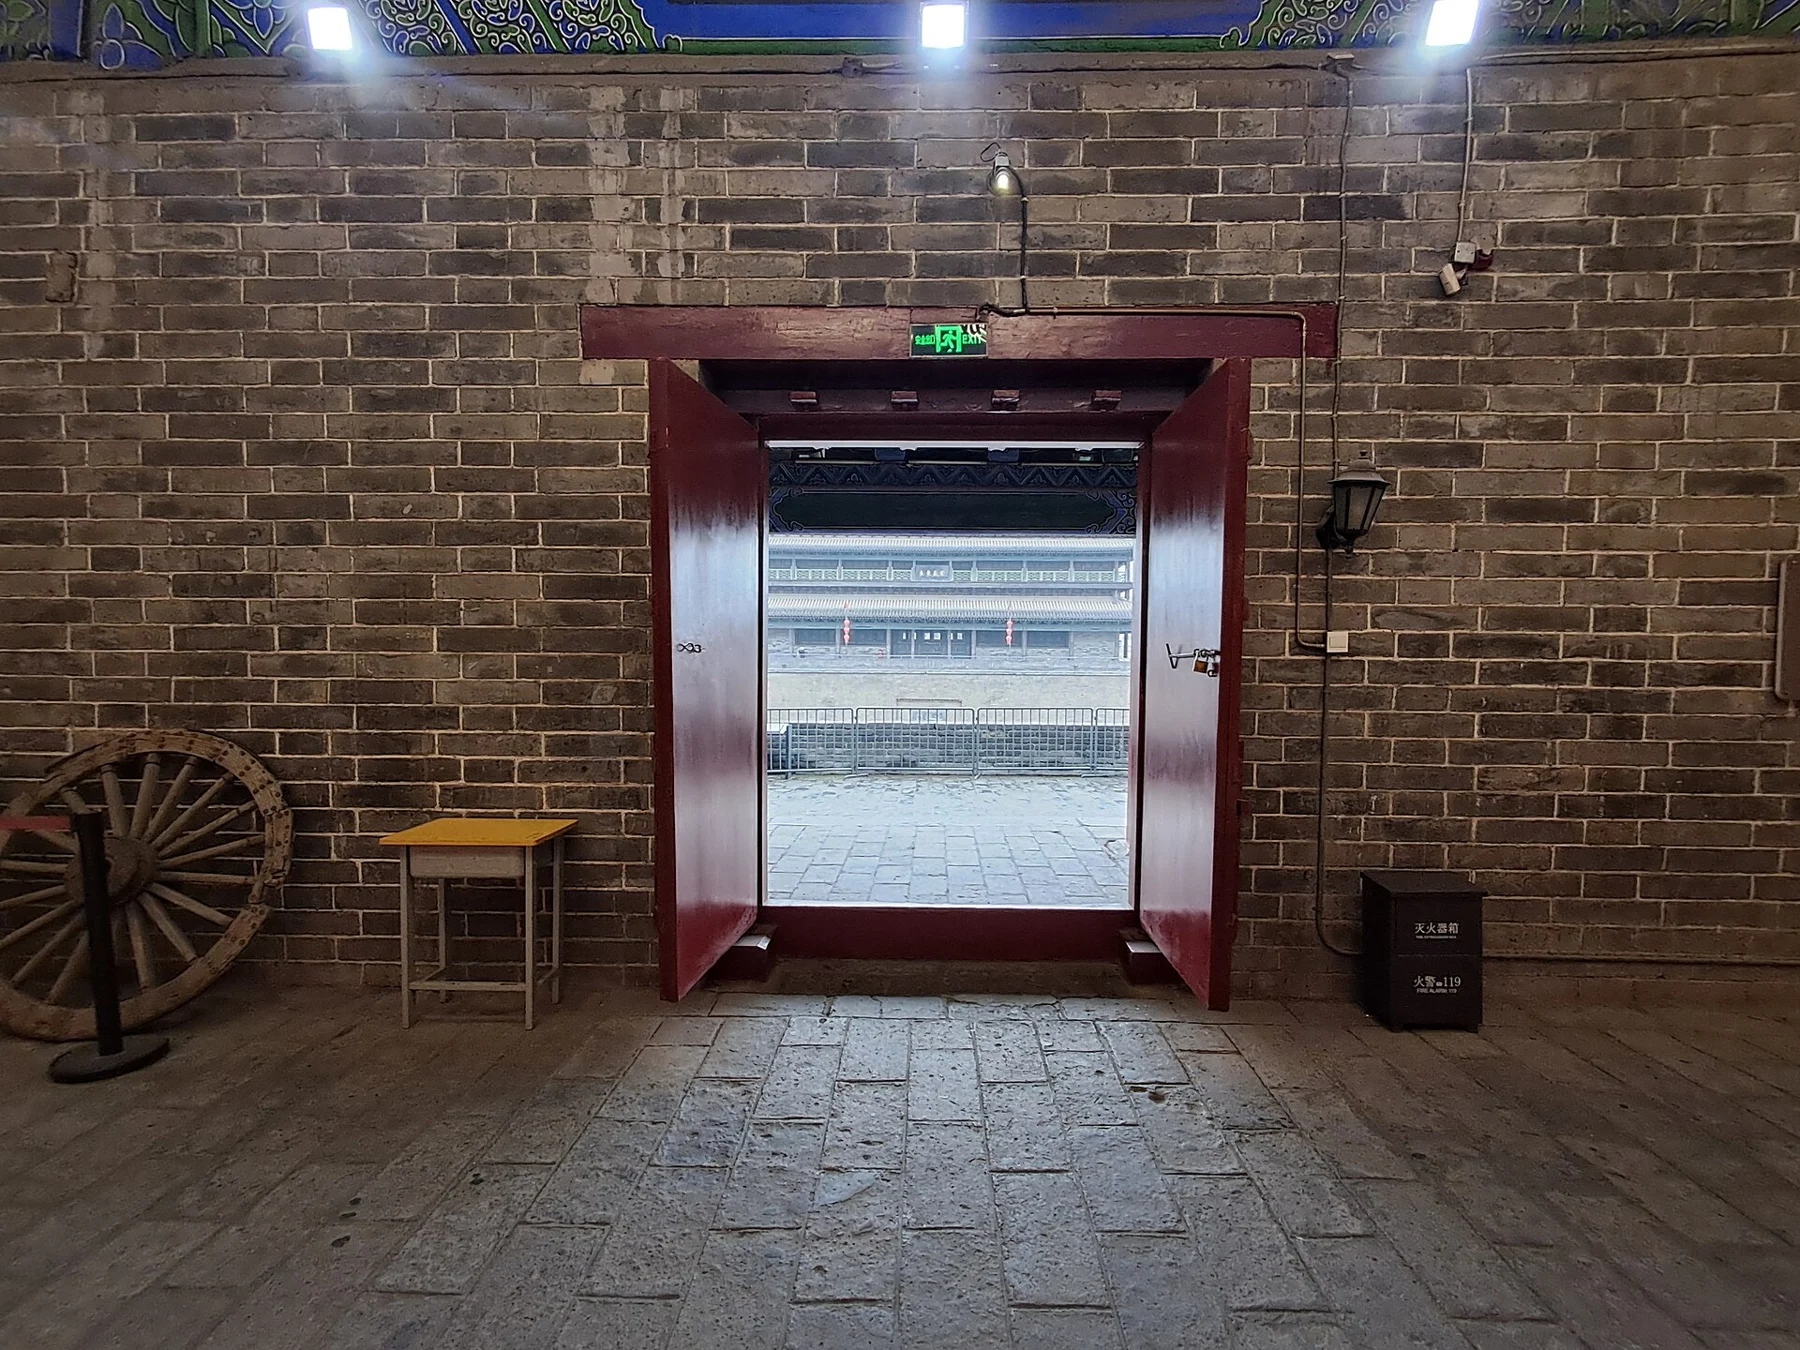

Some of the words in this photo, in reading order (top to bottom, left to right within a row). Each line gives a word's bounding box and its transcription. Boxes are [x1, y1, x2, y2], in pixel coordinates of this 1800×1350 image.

[962, 333, 982, 345] EXIT
[1414, 922, 1459, 934] 灭火器箱
[1443, 976, 1461, 987] 119
